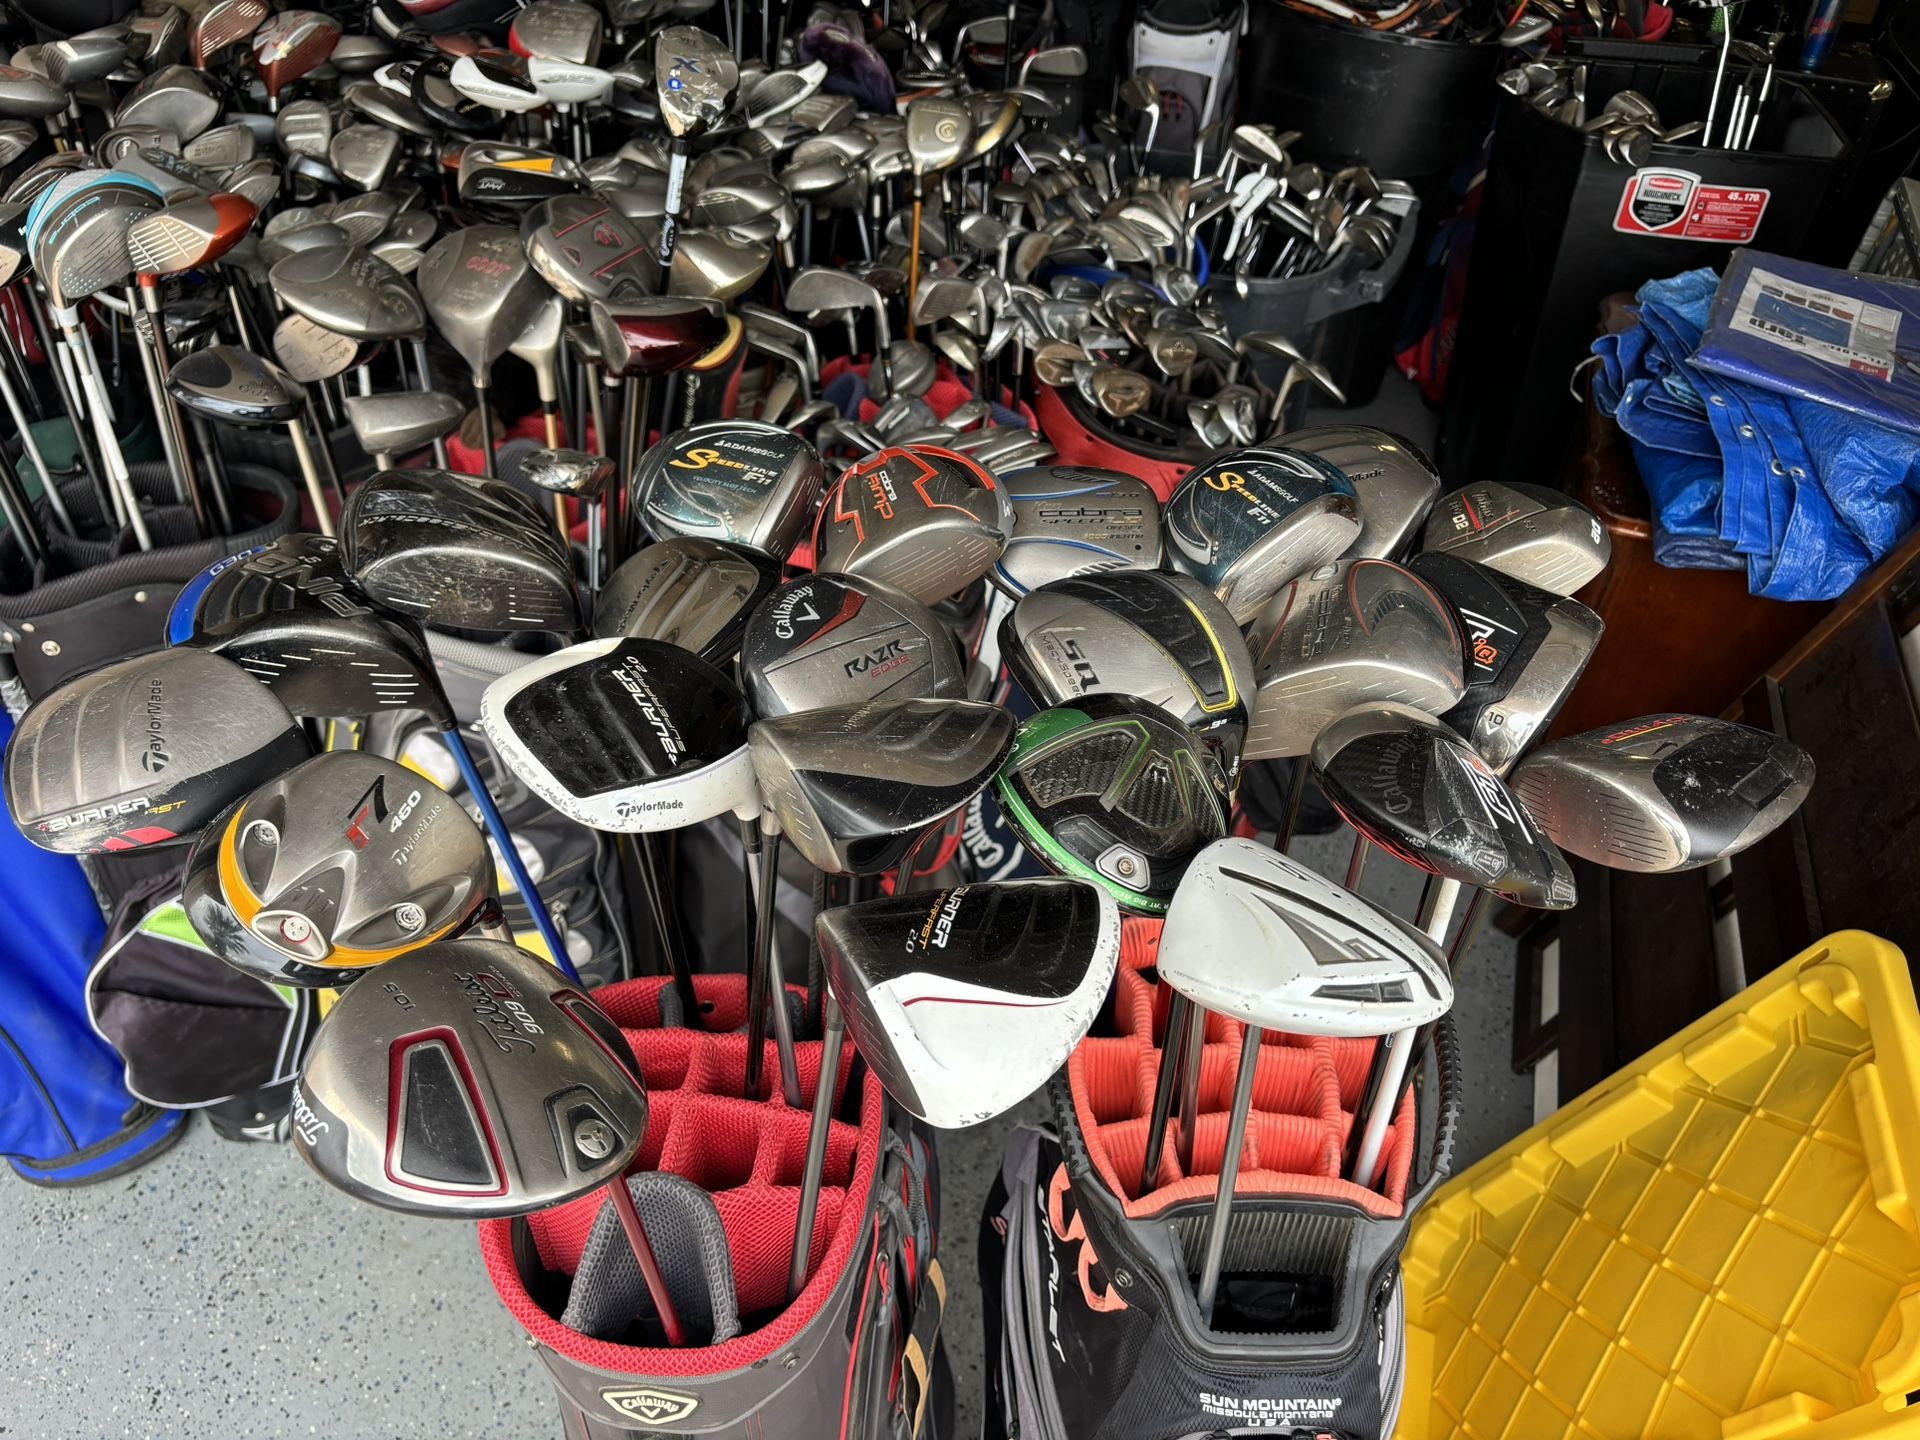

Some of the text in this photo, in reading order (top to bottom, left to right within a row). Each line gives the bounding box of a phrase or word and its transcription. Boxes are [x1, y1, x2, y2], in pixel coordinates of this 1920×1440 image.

[1039, 507, 1143, 517] cobra
[210, 550, 252, 577] G30
[772, 584, 814, 639] Callaway
[844, 639, 904, 678] RAZR
[871, 654, 910, 678] EDGE
[142, 679, 170, 772] TaylorMade
[612, 669, 678, 755] BURNER
[1488, 711, 1504, 726] 10
[50, 797, 150, 832] BURNER
[390, 790, 421, 833] 460
[616, 800, 683, 817] TaylorMade
[454, 971, 537, 1053] Titleist
[1038, 1184, 1066, 1363] STARLET
[622, 1396, 679, 1412] Callaway
[1200, 1393, 1238, 1409] SUN
